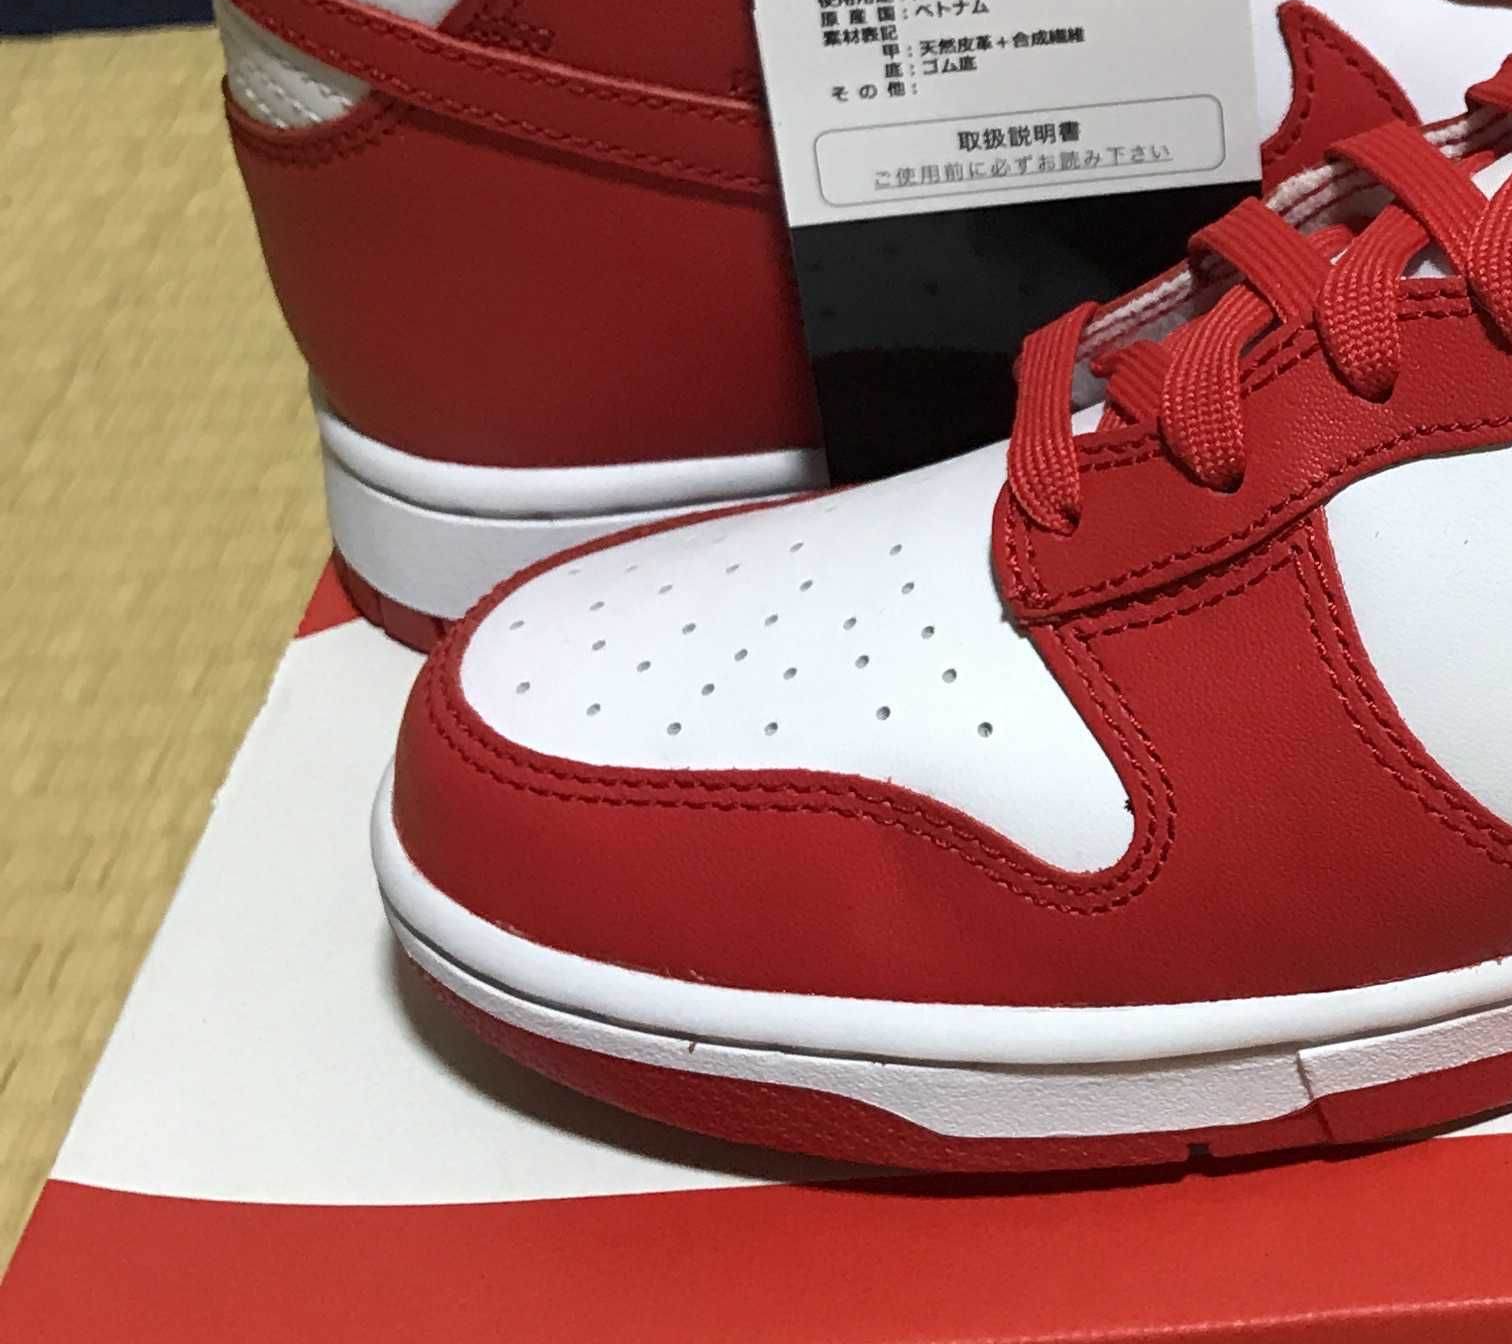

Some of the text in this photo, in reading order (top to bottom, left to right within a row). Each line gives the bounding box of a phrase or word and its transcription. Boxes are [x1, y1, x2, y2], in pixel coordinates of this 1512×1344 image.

[957, 121, 1080, 152] 取扱説明書
[874, 145, 1172, 187] ご使用前に必ずお読み下さい
